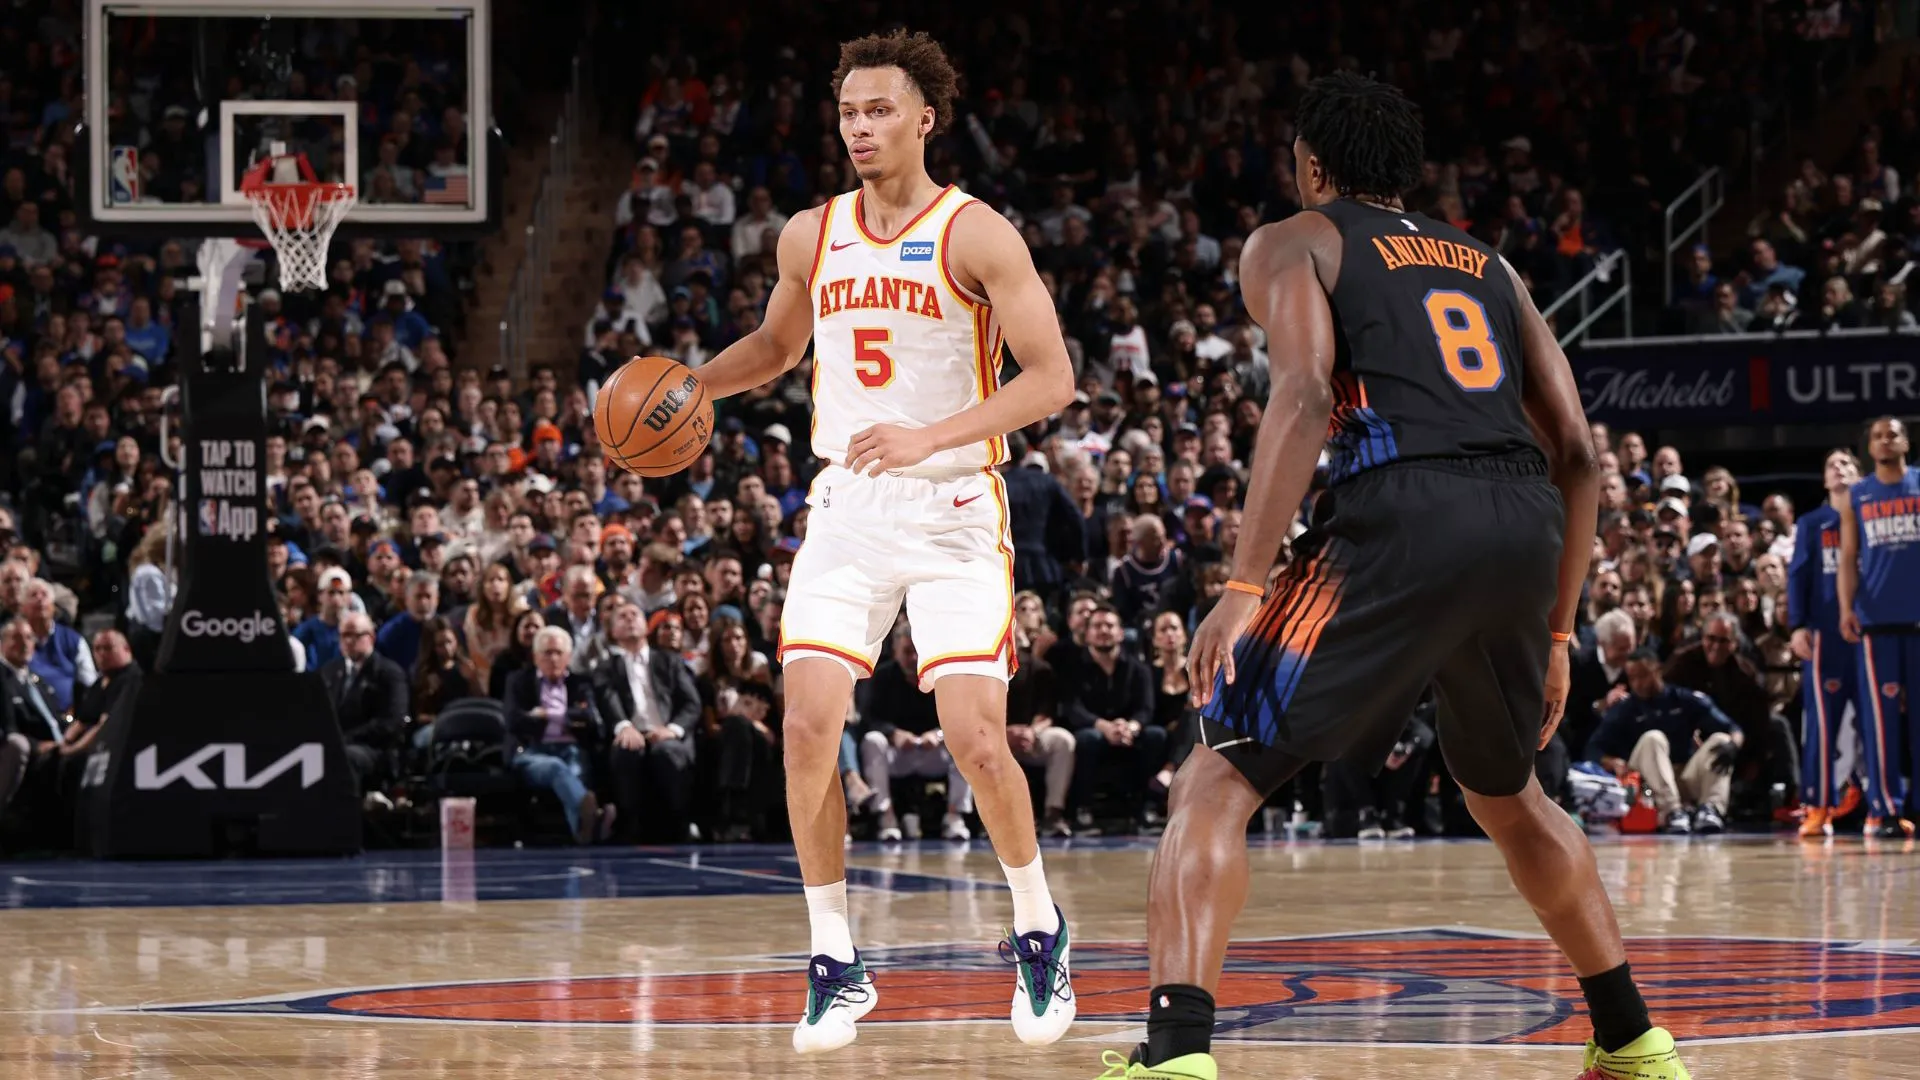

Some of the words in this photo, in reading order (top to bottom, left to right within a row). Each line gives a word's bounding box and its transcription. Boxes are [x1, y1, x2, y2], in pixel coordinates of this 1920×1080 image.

[902, 246, 932, 257] paze
[1371, 235, 1489, 280] ANUNOBY
[818, 275, 944, 322] ATLANTA
[851, 326, 897, 391] 5
[1422, 287, 1506, 393] 8
[643, 373, 699, 433] Wilson
[1582, 367, 1736, 414] Michelob
[1786, 362, 1920, 404] ULTR
[200, 440, 231, 468] TAP
[234, 440, 256, 468] TO
[200, 469, 257, 497] WATCH
[218, 500, 258, 542] App
[180, 609, 276, 643] Google
[134, 742, 324, 790] KIA
